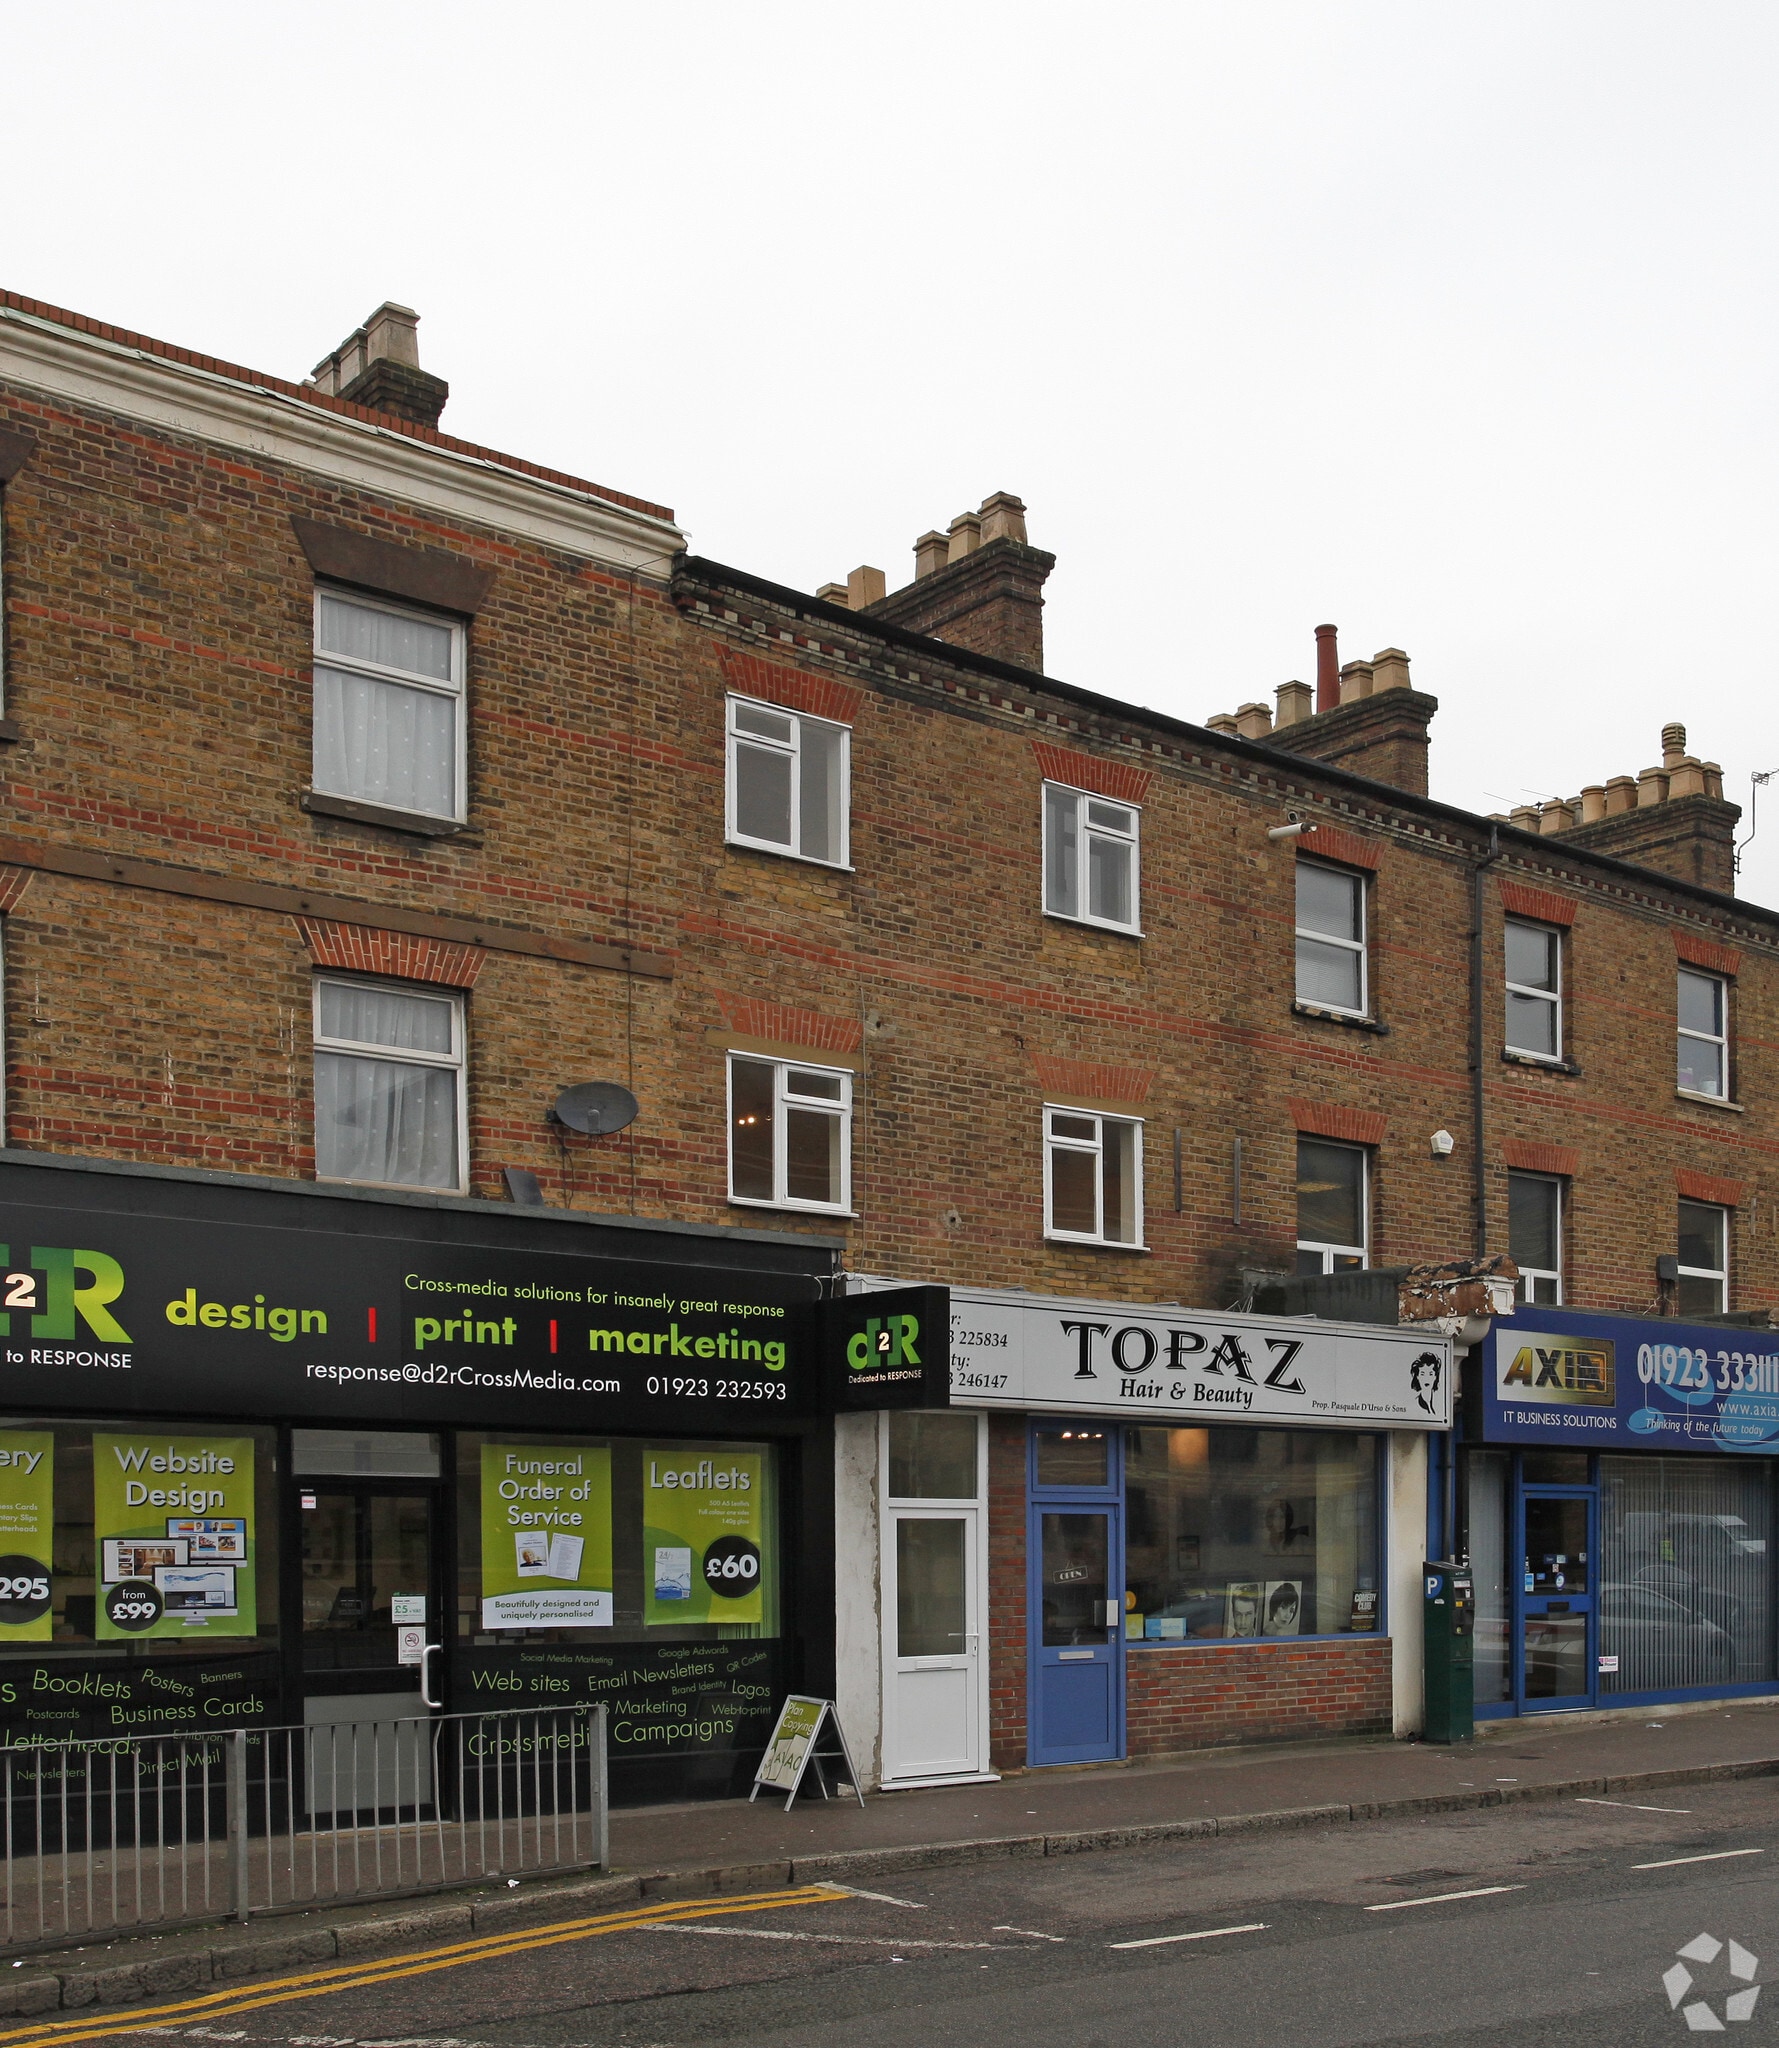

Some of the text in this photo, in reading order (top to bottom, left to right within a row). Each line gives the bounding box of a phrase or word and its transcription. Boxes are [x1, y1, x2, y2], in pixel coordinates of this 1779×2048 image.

[404, 1273, 785, 1319] Cross-media solutions for insanely great response
[165, 1288, 787, 1371] design print marketing
[959, 1330, 1008, 1348] 225834
[6, 1348, 132, 1369] to RESPONSE
[1060, 1320, 1306, 1395] TOPAZ
[1637, 1343, 1709, 1388] 01923
[848, 1369, 923, 1384] Dedicated to RESPONSE
[1502, 1346, 1606, 1391] AXIA
[305, 1363, 787, 1401] response@d2rCrossMedia.com 01923 232593
[958, 1372, 1008, 1389] 246147
[1119, 1378, 1254, 1410] Hair & Beauty
[1311, 1400, 1330, 1410] Prop.
[1331, 1401, 1360, 1412] Pasquale
[1385, 1404, 1391, 1412] &
[1391, 1404, 1407, 1413] Sons
[1503, 1410, 1617, 1429] IT BUSINESS SOLUTIONS
[1646, 1417, 1764, 1437] Thinking of the future today
[113, 1446, 235, 1475] Website
[505, 1453, 583, 1476] Funeral
[650, 1460, 752, 1490] Leaflets
[126, 1481, 225, 1513] Design
[498, 1479, 591, 1501] Order of
[507, 1505, 583, 1526] Service
[706, 1554, 758, 1579] £60
[1060, 1569, 1082, 1580] OPEN
[122, 1589, 146, 1600] from
[1427, 1577, 1438, 1595] P
[112, 1602, 156, 1620] £99
[495, 1599, 600, 1609] Beautifully designed and
[501, 1610, 594, 1620] uniquely personalised
[520, 1652, 614, 1666] Social Media Marketing
[658, 1645, 729, 1659] Google Adwords
[726, 1652, 768, 1673] QR Codes
[32, 1668, 131, 1699] Booklets
[141, 1668, 195, 1698] Posters
[200, 1670, 243, 1684] Banners
[472, 1669, 570, 1692] Web sites
[588, 1662, 715, 1692] Email Newsletters
[671, 1680, 727, 1695] Brand Identity
[732, 1679, 771, 1699] Logos
[26, 1708, 80, 1720] Postcards
[111, 1693, 265, 1725] Business Cards
[614, 1698, 687, 1717] Marketing
[711, 1704, 772, 1717] Web-to-print
[787, 1702, 804, 1716] Plan
[614, 1718, 735, 1745] Campaigns
[782, 1716, 815, 1736] Copying
